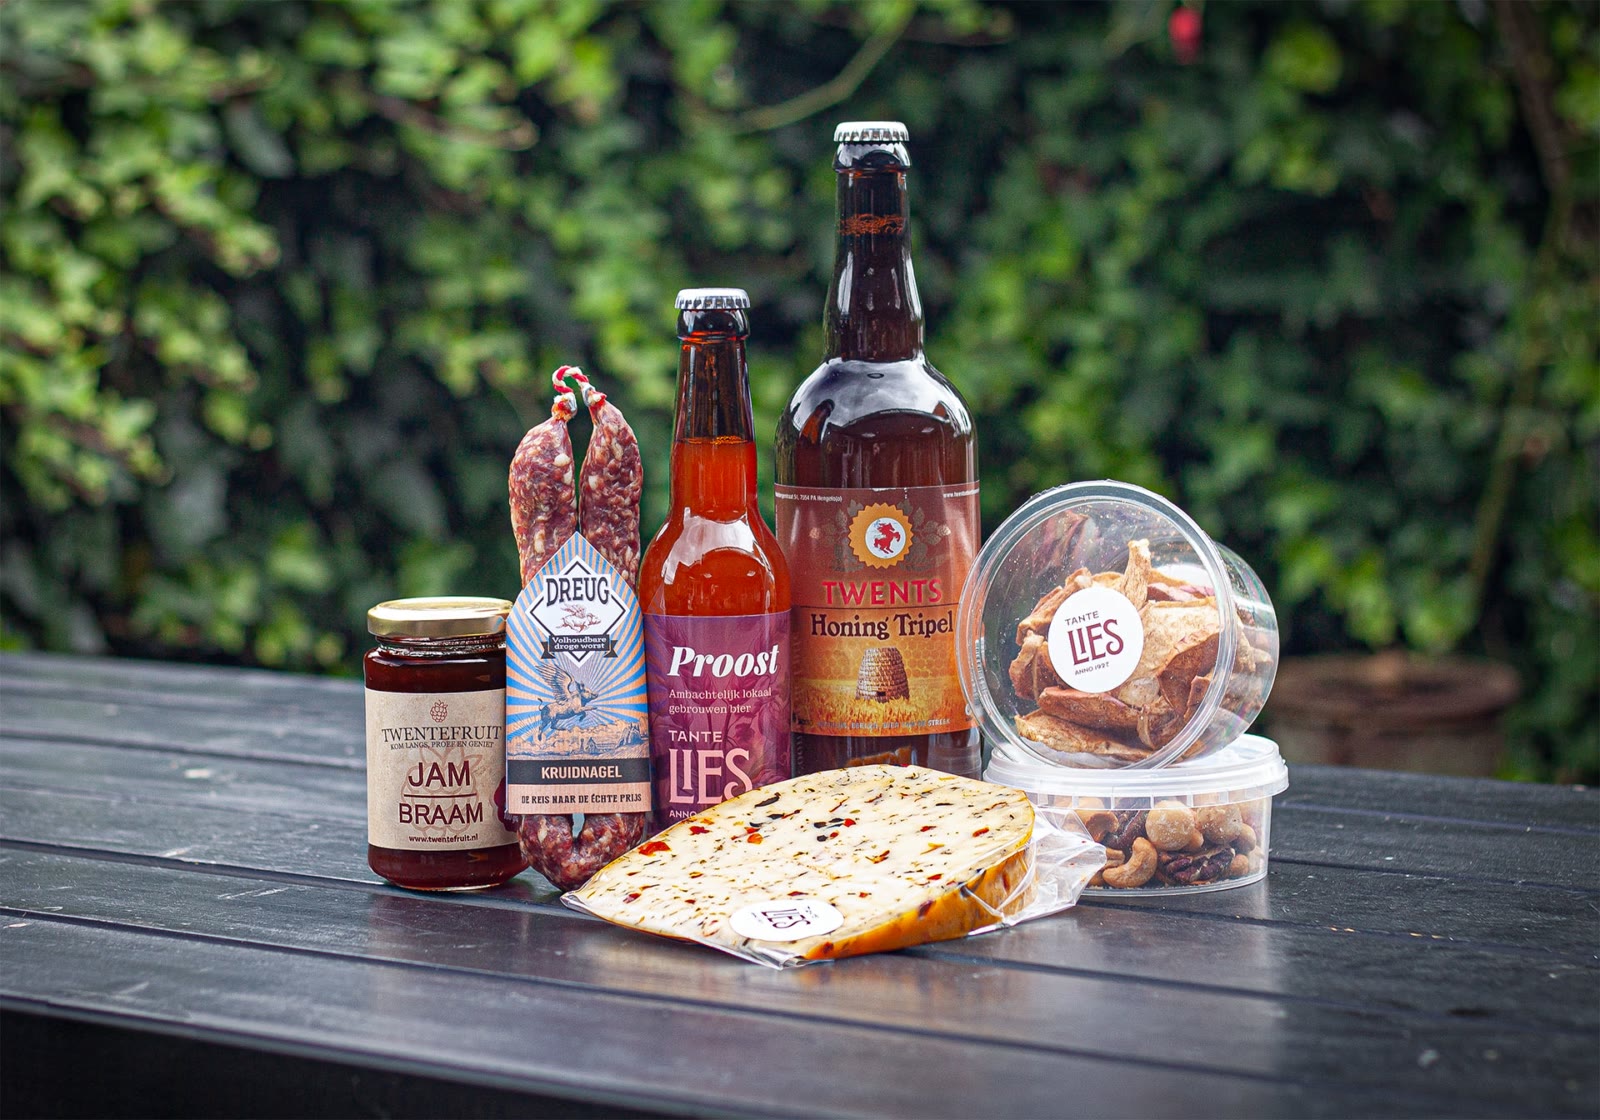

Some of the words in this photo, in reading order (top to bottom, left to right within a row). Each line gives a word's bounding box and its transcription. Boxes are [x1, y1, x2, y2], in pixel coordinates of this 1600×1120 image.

[546, 576, 610, 607] DREUG
[822, 579, 943, 606] TWENTS
[811, 613, 890, 640] Honing
[894, 611, 953, 638] Tripel
[1065, 610, 1099, 626] TANTE
[552, 636, 607, 644] Volhoudbare
[1067, 619, 1124, 665] LIES
[667, 644, 779, 678] Proost
[1075, 666, 1094, 675] ANNO
[669, 689, 740, 701] Ambachtelijk
[743, 687, 772, 698] lokaal
[669, 704, 727, 715] gebrouwen
[730, 704, 751, 714] bier
[382, 726, 502, 742] TWENTEFRUIT
[668, 730, 722, 742] TANTE
[405, 742, 430, 750] LANGS,
[408, 760, 470, 787] JAM
[541, 765, 622, 780] KRUIDNAGEL
[669, 748, 753, 805] LIES
[521, 796, 530, 804] DE
[531, 795, 550, 804] REIS
[552, 795, 576, 804] NAAR
[578, 795, 589, 803] DE
[590, 793, 618, 803] ÉCHTE
[619, 793, 642, 802] PRIJS
[399, 801, 484, 825] BRAAM
[408, 833, 478, 843] www.twentefruit.nl
